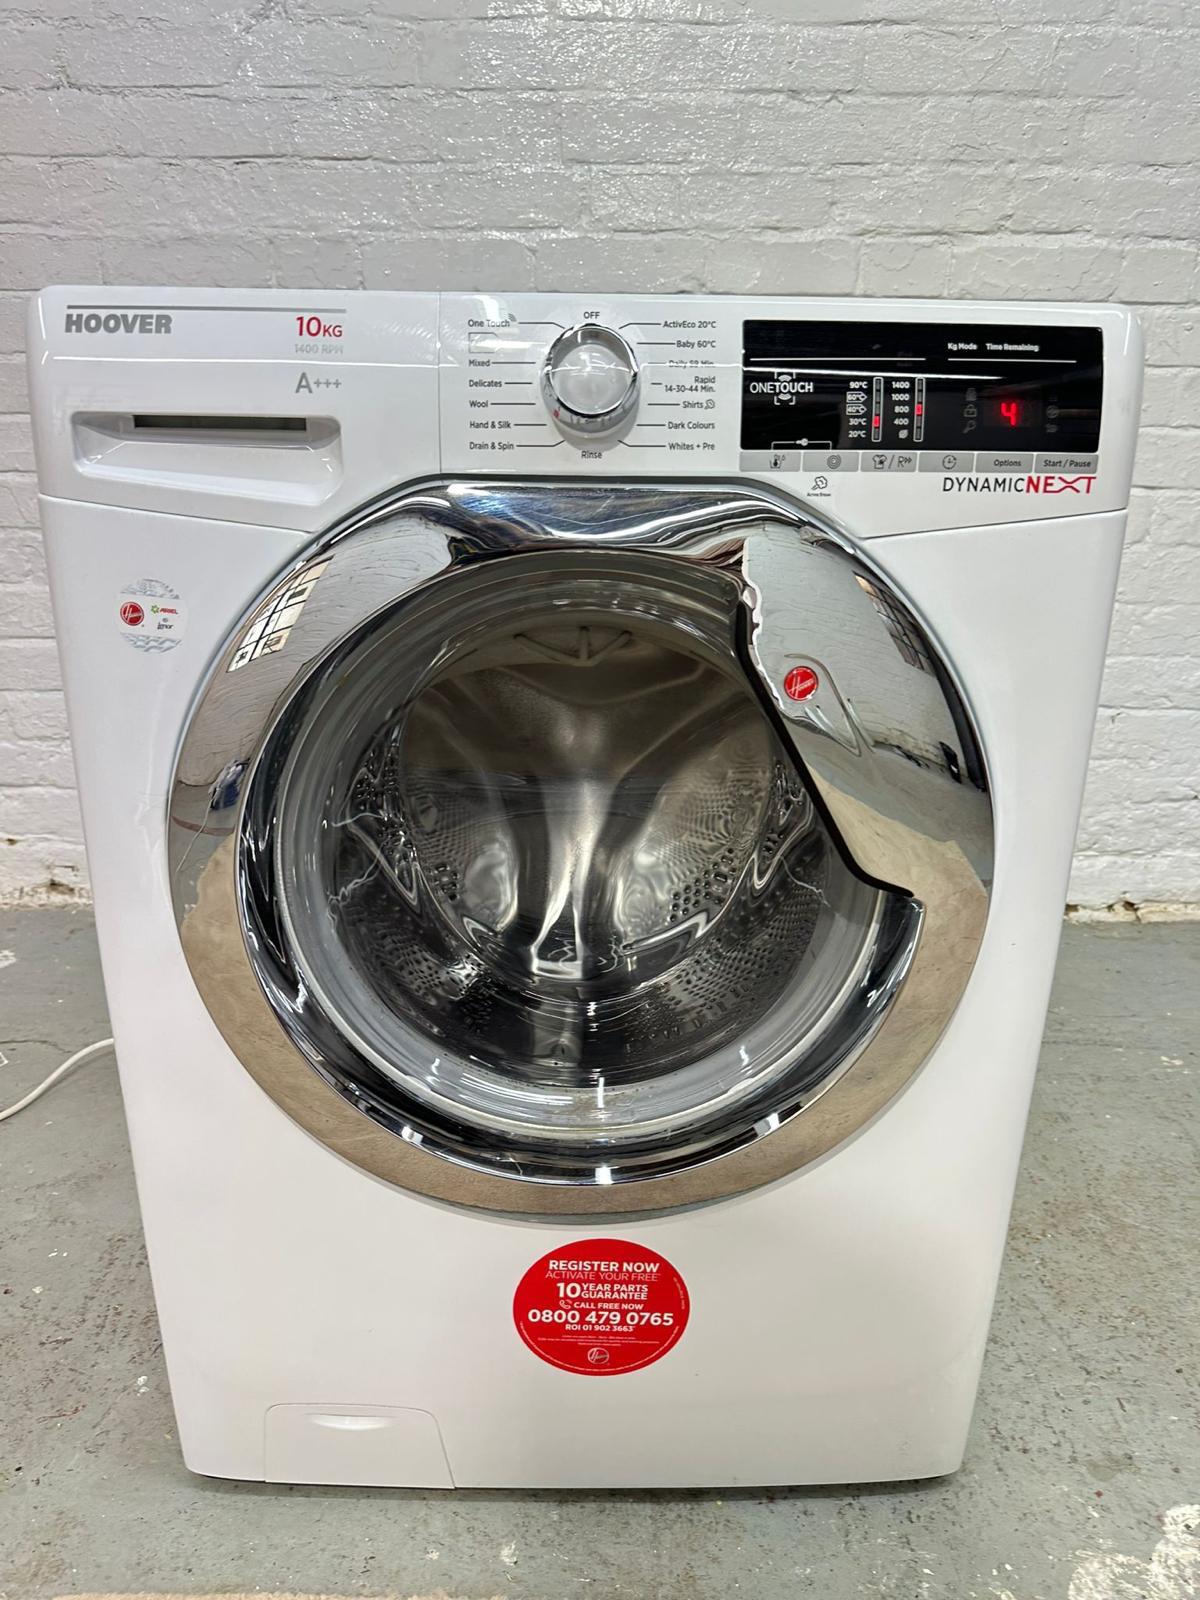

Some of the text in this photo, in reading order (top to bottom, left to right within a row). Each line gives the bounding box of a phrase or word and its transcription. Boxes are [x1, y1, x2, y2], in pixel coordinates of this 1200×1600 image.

[583, 311, 600, 319] OFF
[65, 313, 173, 334] HOOVER
[296, 316, 343, 337] 10KG
[468, 319, 510, 327] One Touch
[663, 320, 717, 328] ActivEco 20°C
[295, 343, 344, 354] 1400 RPM
[676, 340, 716, 349] Baby 60°C
[947, 342, 978, 351] Kg Mode
[1003, 343, 1040, 353] Remaining
[468, 359, 491, 367] Mixed
[295, 372, 342, 394] A+++
[468, 379, 502, 387] Delicates
[694, 375, 716, 385] Rapid
[664, 384, 716, 392] 14-30-44 Min.
[849, 381, 868, 389] 90°C
[892, 381, 910, 389] 1400
[891, 393, 910, 401] 1000
[469, 399, 489, 408] Wool
[682, 400, 703, 408] Shirts
[894, 405, 909, 414] 800
[1001, 402, 1017, 426] 4
[469, 420, 511, 429] Hand & Silk
[667, 421, 716, 429] Dark Colours
[848, 418, 867, 426] 30°C
[893, 418, 909, 426] 400
[848, 430, 866, 438] 20°C
[469, 441, 514, 451] Drain & Spin
[668, 442, 694, 451] Whites
[702, 442, 715, 451] Pre
[581, 450, 602, 459] Rinse
[993, 458, 1022, 468] Options
[1043, 459, 1062, 468] Start
[1069, 459, 1092, 468] Pause
[549, 1260, 660, 1273] REGISTER NOW
[545, 1270, 596, 1280] ACTIVATE
[599, 1272, 630, 1281] YOUR
[556, 1282, 648, 1298] 10 YEAR PARTS
[581, 1291, 648, 1300] GUARANTEE
[573, 1301, 596, 1309] CALL
[528, 1309, 674, 1326] 0800 479 0765
[593, 1324, 611, 1332] 902
